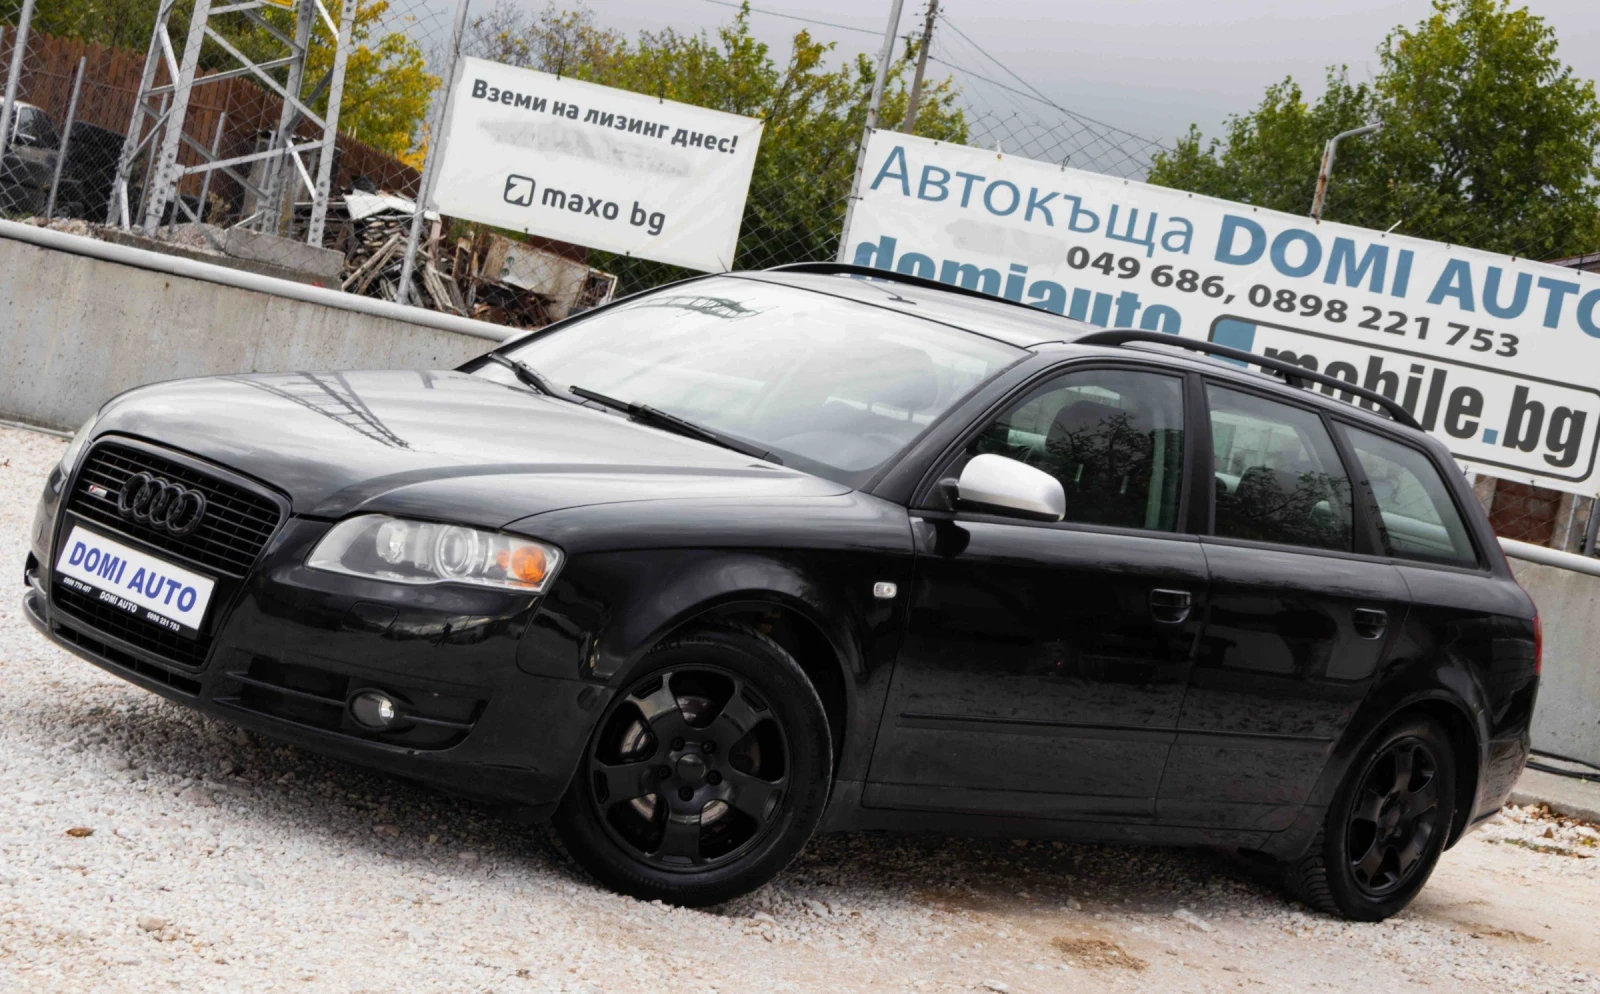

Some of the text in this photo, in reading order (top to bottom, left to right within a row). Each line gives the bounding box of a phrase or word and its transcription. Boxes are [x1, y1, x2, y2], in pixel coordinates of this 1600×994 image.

[471, 78, 739, 155] Вземи на лизинг днес!
[541, 187, 666, 236] maxo bg
[870, 144, 1195, 259] Автокъща
[1213, 213, 1416, 299] DOMI
[1066, 246, 1520, 358] 049 686, 0898 221 753
[68, 541, 197, 613] DOMI AUTO
[99, 591, 119, 605] DOMI
[118, 599, 138, 613] AUTO
